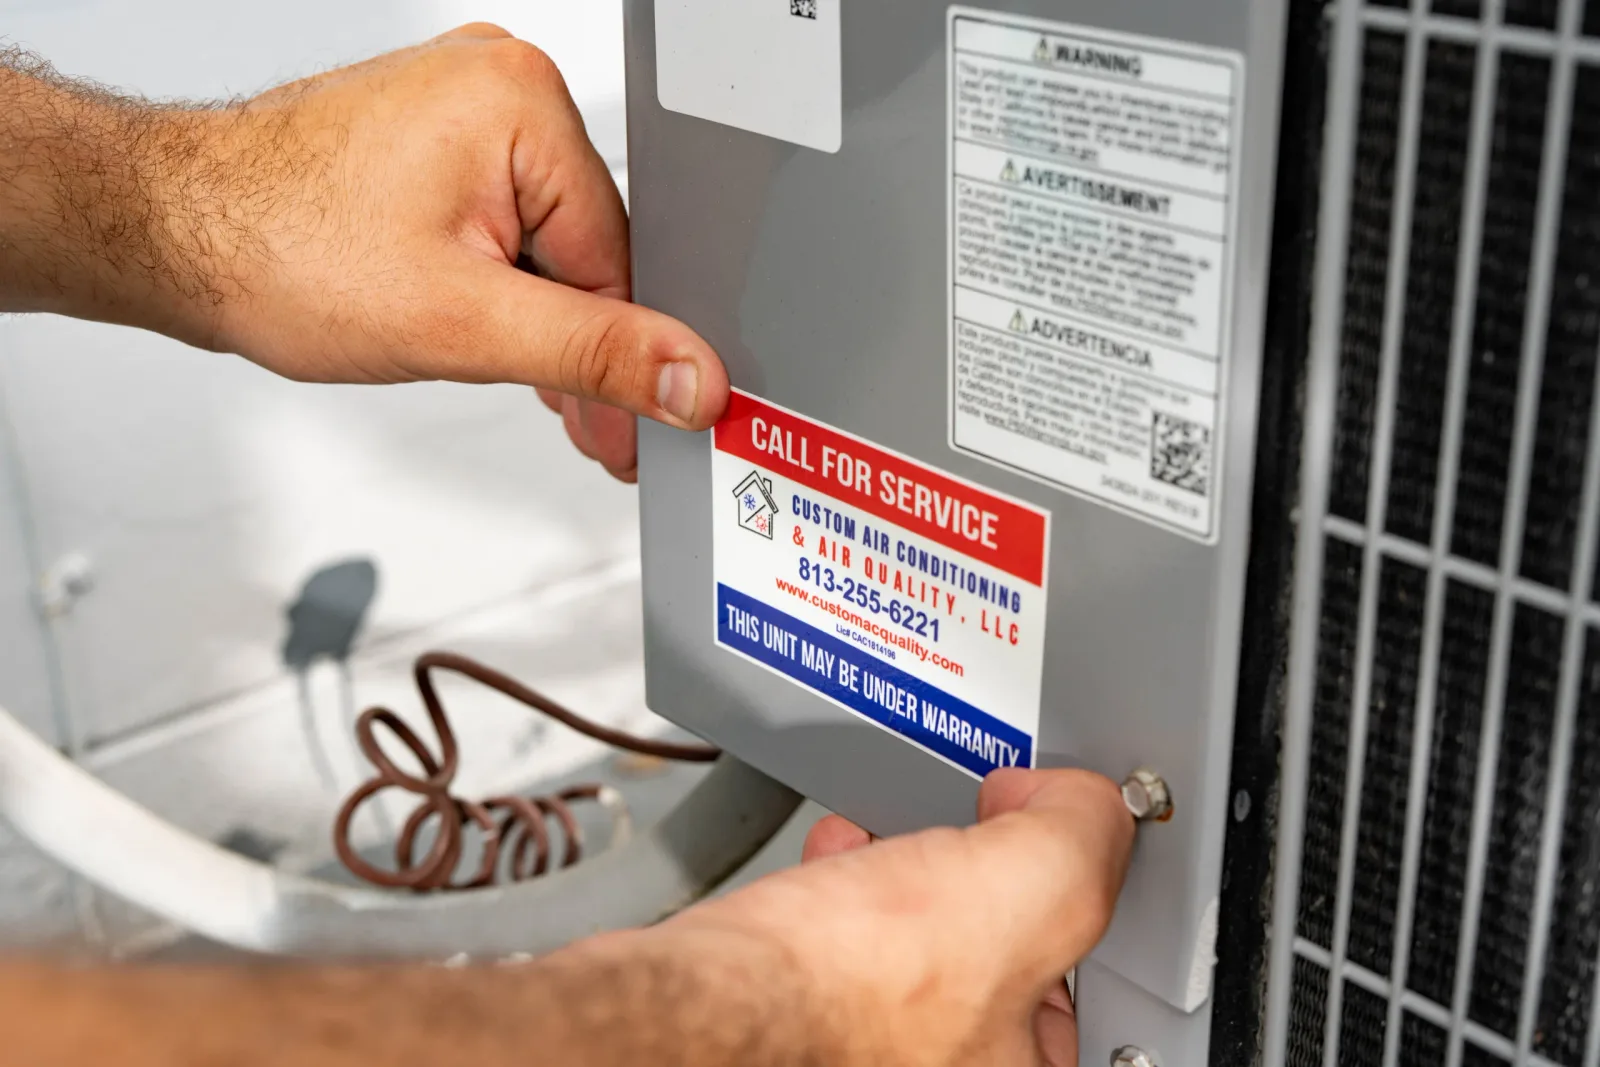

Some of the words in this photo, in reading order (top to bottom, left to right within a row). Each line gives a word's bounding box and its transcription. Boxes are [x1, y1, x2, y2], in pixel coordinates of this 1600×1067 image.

[1056, 45, 1143, 77] WARNING
[1023, 166, 1170, 216] AVERTISSEMENT
[1031, 318, 1153, 369] ADVERTENCIA
[751, 416, 815, 473] CALL
[822, 445, 871, 496] FOR
[879, 471, 998, 550] SERVICE
[792, 494, 855, 540] CUSTOM
[863, 525, 889, 555] AIR
[897, 540, 1021, 614] CONDITIONING
[792, 525, 805, 547] &
[818, 536, 851, 568] AIR
[864, 556, 966, 623] QUALITY,
[981, 610, 1019, 646] LLC
[799, 557, 940, 642] 813-255-6221
[775, 578, 964, 677] www.customacquality.com
[836, 624, 851, 638] Lic#
[852, 630, 896, 660] CAC1814196
[726, 603, 759, 642] THIS
[763, 621, 797, 660] UNIT
[801, 640, 835, 679] MAY
[839, 659, 859, 693] BE
[863, 671, 918, 723] UNDER
[921, 700, 1020, 769] WARRANTY
